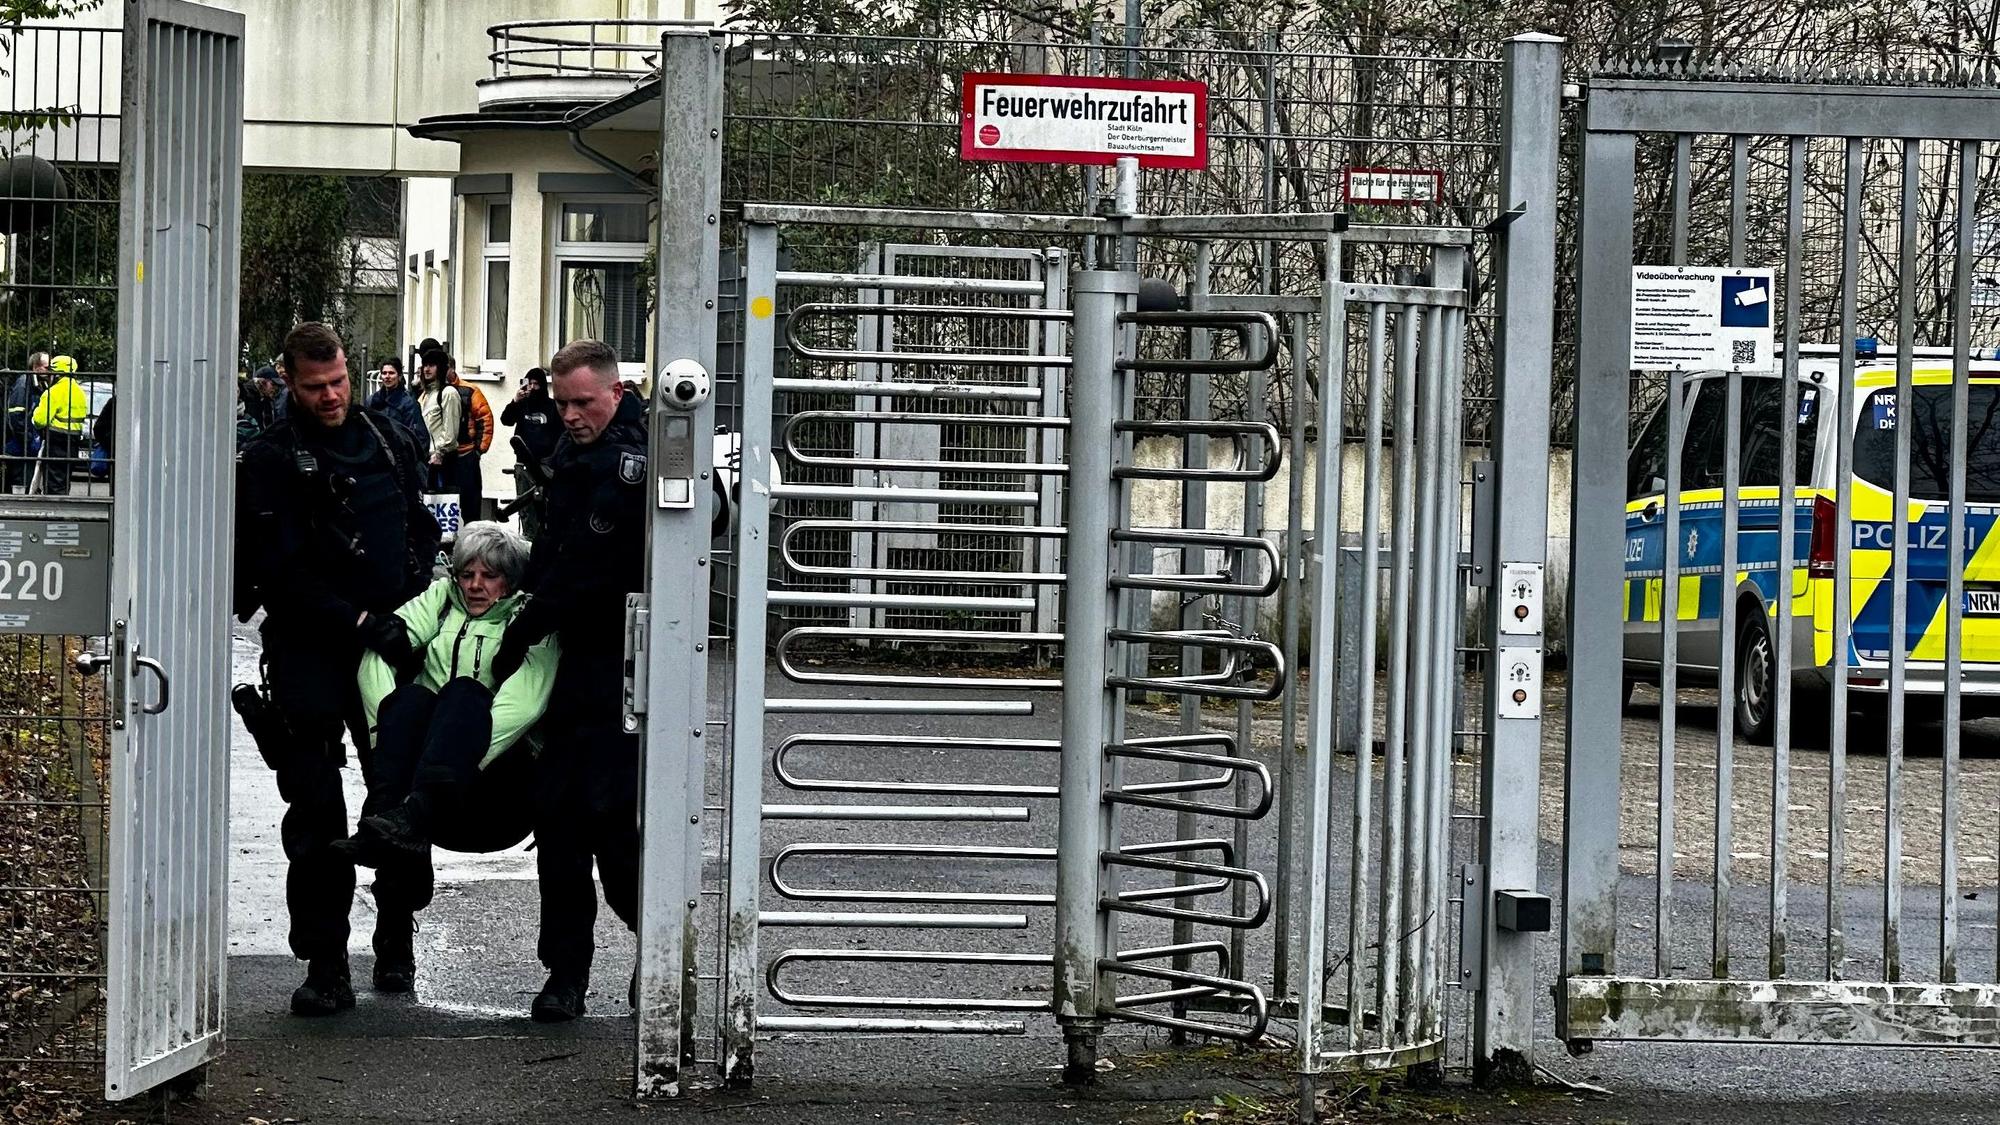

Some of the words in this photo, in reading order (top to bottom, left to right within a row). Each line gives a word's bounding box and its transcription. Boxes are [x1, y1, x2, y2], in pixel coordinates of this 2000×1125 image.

[982, 88, 1188, 124] Feuerwehrzufahrt
[1107, 123, 1126, 131] Stadt
[1107, 132, 1120, 140] Der
[1107, 142, 1164, 151] Bauaufsichtsamt
[1375, 177, 1385, 187] für
[1398, 178, 1435, 188] Feuerweh
[1636, 271, 1715, 283] Videoüberwachung
[1874, 394, 1896, 405] NR
[1855, 523, 1975, 550] POIZI
[0, 559, 63, 601] 220
[1968, 592, 2000, 611] NRW
